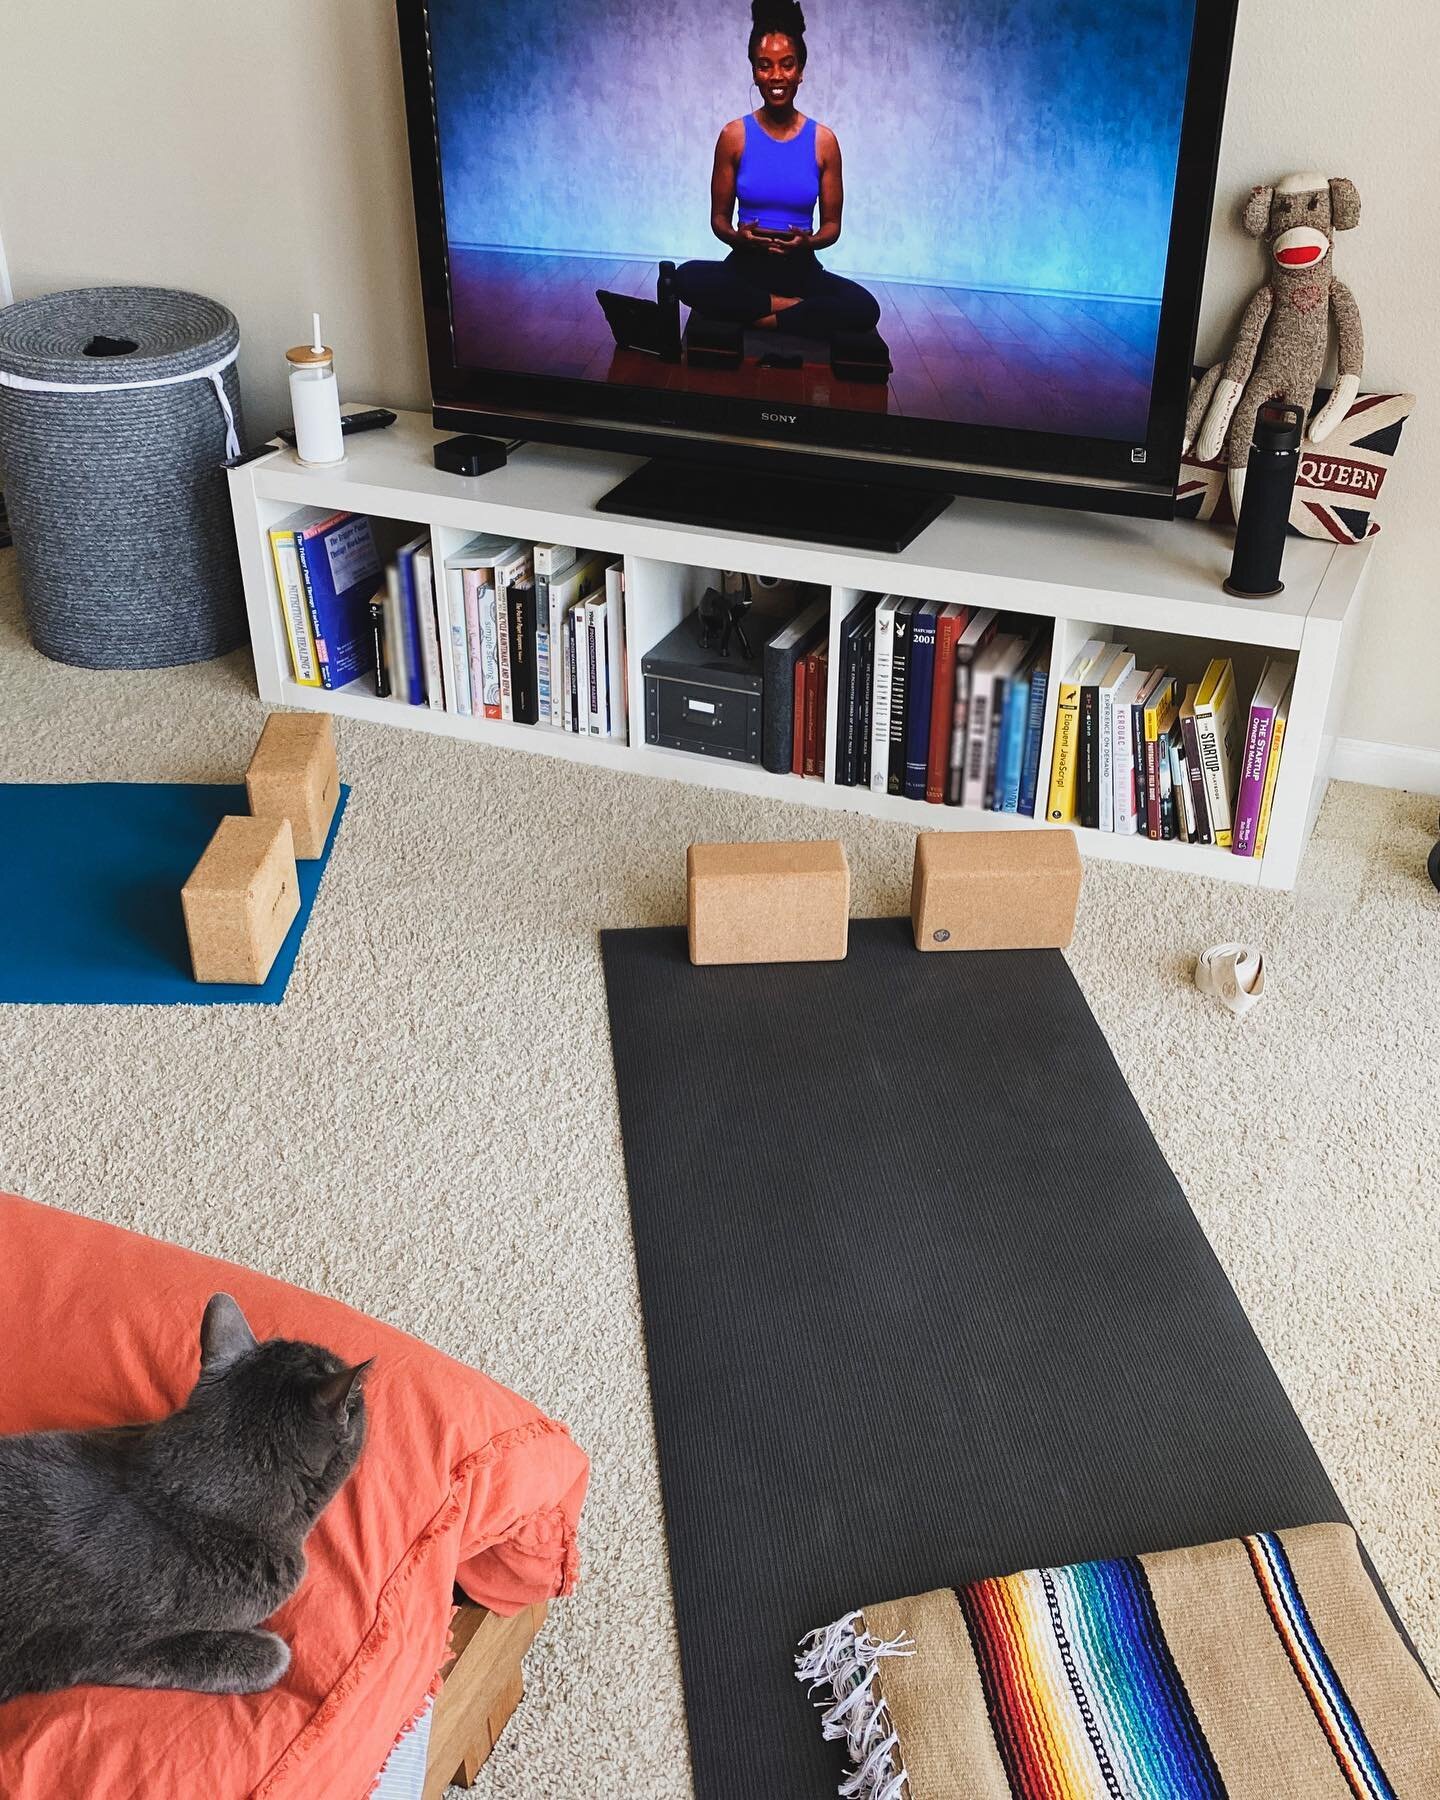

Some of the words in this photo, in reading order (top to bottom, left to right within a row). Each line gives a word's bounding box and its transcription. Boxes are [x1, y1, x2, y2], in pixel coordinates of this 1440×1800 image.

[761, 413, 796, 423] SONY
[1295, 459, 1379, 491] QUEEN
[299, 547, 308, 568] Trigger
[306, 586, 314, 608] Therapy
[312, 610, 321, 637] Workbook
[288, 584, 306, 634] NUTRITIONAL
[297, 637, 310, 669] HEALING
[485, 622, 494, 649] simple
[913, 634, 934, 644] 2001
[500, 633, 509, 667] MAINTENANCE
[878, 653, 889, 667] THE
[893, 655, 906, 672] THE
[486, 651, 494, 680] sewing
[876, 674, 888, 716] PLAYMATE
[891, 677, 905, 715] PLAYBOY
[875, 722, 887, 744] BOOK
[890, 721, 903, 743] BOOK
[1062, 714, 1072, 747] Eloquent
[1104, 737, 1110, 747] ON
[1117, 710, 1125, 745] KEROUAC
[1250, 718, 1259, 750] OWNER'S
[1258, 718, 1269, 738] THE
[1275, 724, 1283, 734] THE
[1201, 733, 1220, 772] STARTUP
[1272, 735, 1281, 752] BEATS
[1057, 749, 1068, 788] JavaScript
[1245, 750, 1255, 779] MANUAL
[1252, 739, 1266, 781] STARTUP
